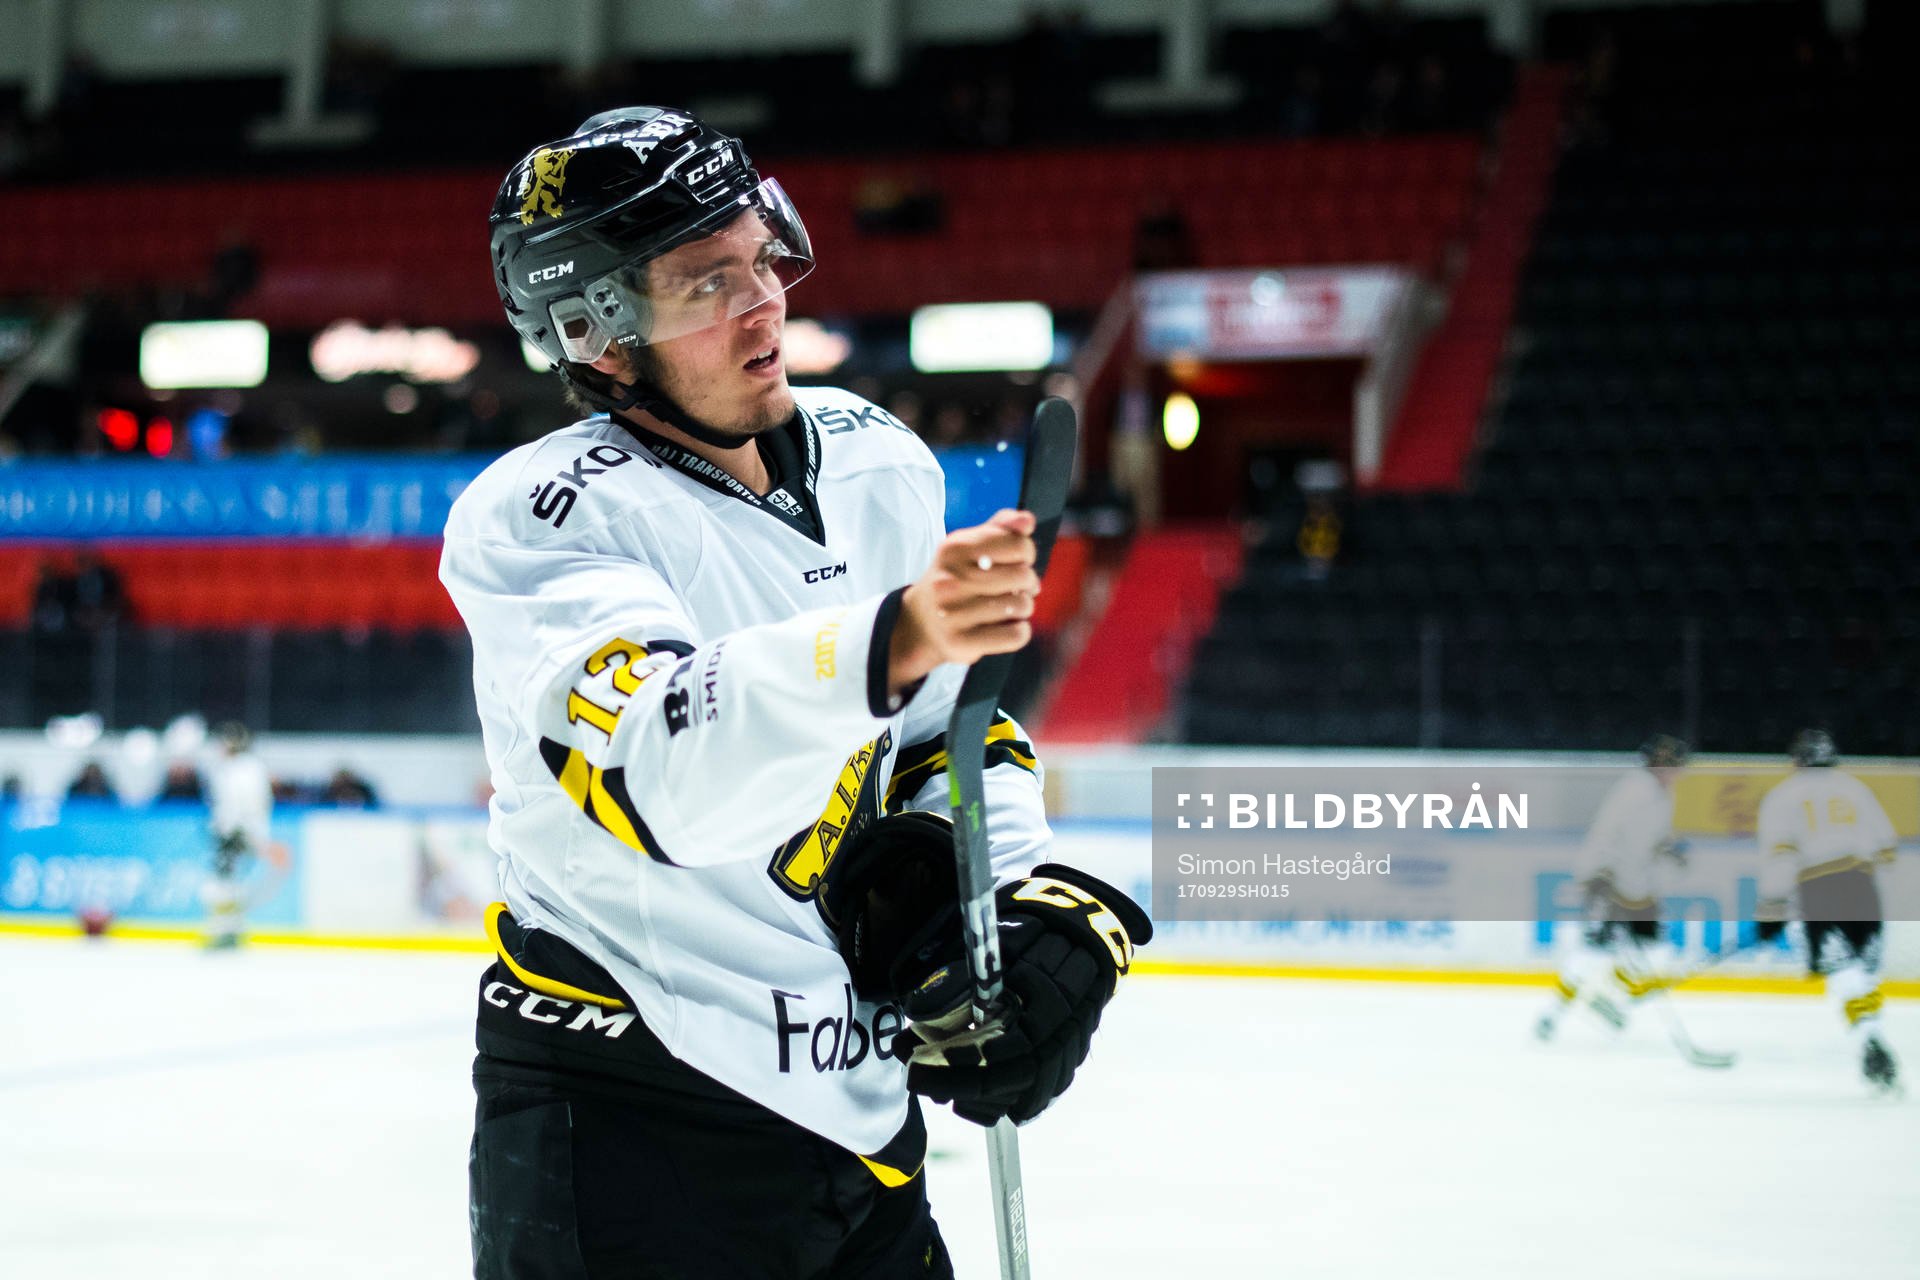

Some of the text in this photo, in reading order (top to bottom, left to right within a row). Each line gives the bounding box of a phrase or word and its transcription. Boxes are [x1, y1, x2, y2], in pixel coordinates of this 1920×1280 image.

[685, 149, 734, 186] CCM
[528, 260, 575, 285] CCM
[617, 334, 637, 345] CCM
[801, 561, 847, 585] CCM
[566, 636, 660, 747] 12
[1011, 877, 1133, 995] CC
[483, 981, 637, 1038] CCM
